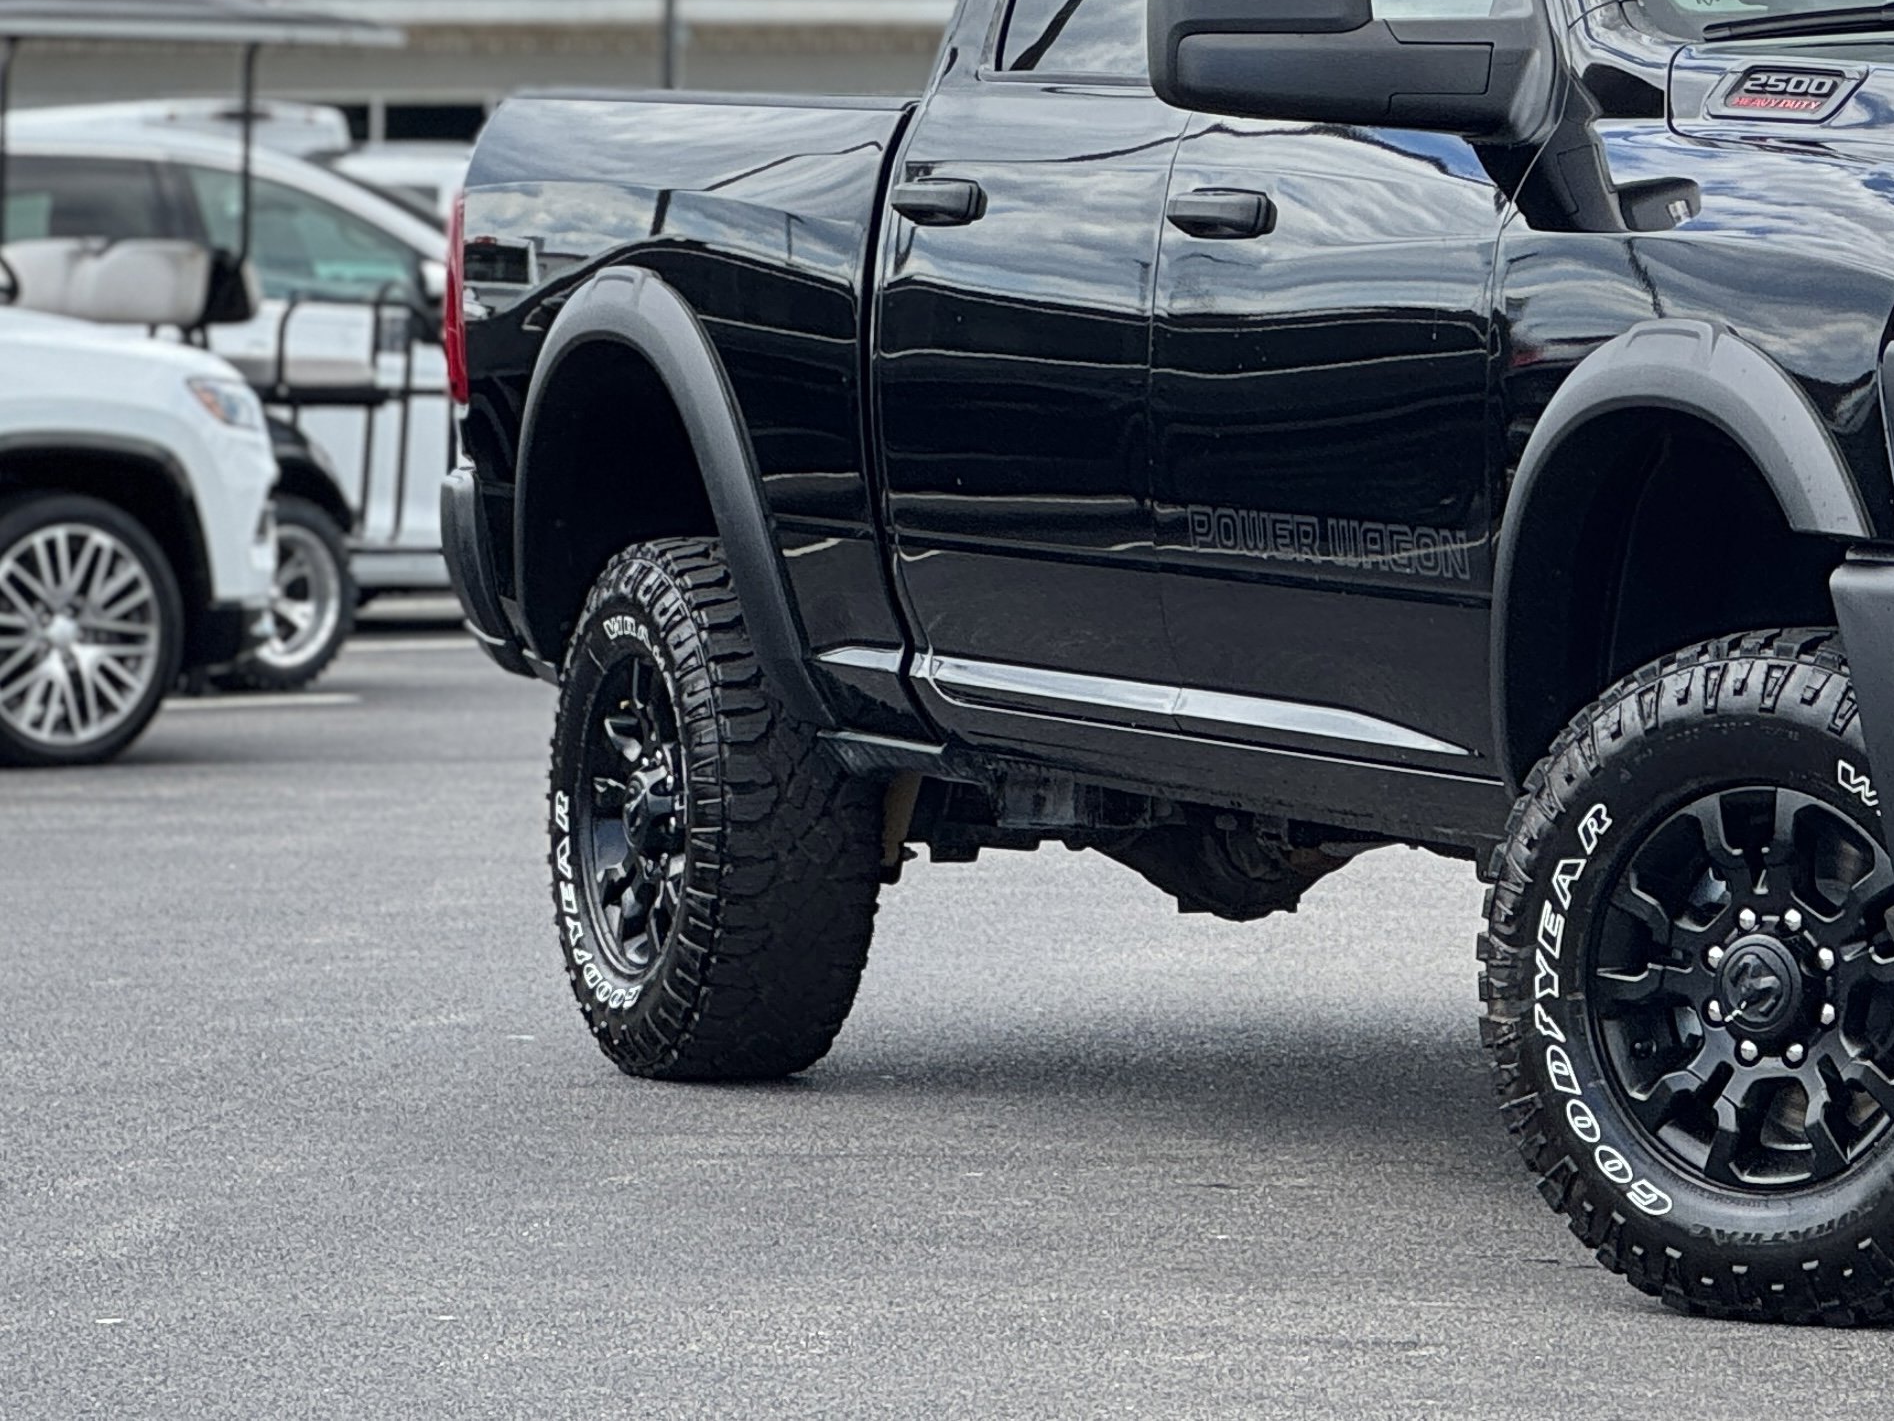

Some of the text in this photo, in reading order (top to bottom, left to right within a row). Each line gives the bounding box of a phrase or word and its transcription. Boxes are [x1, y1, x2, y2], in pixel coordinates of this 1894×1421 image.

[1743, 73, 1833, 94] 2500
[1187, 504, 1470, 579] POWER WAGON
[555, 790, 643, 1009] GOODYEAR
[1534, 803, 1674, 1216] GOODYEAR
